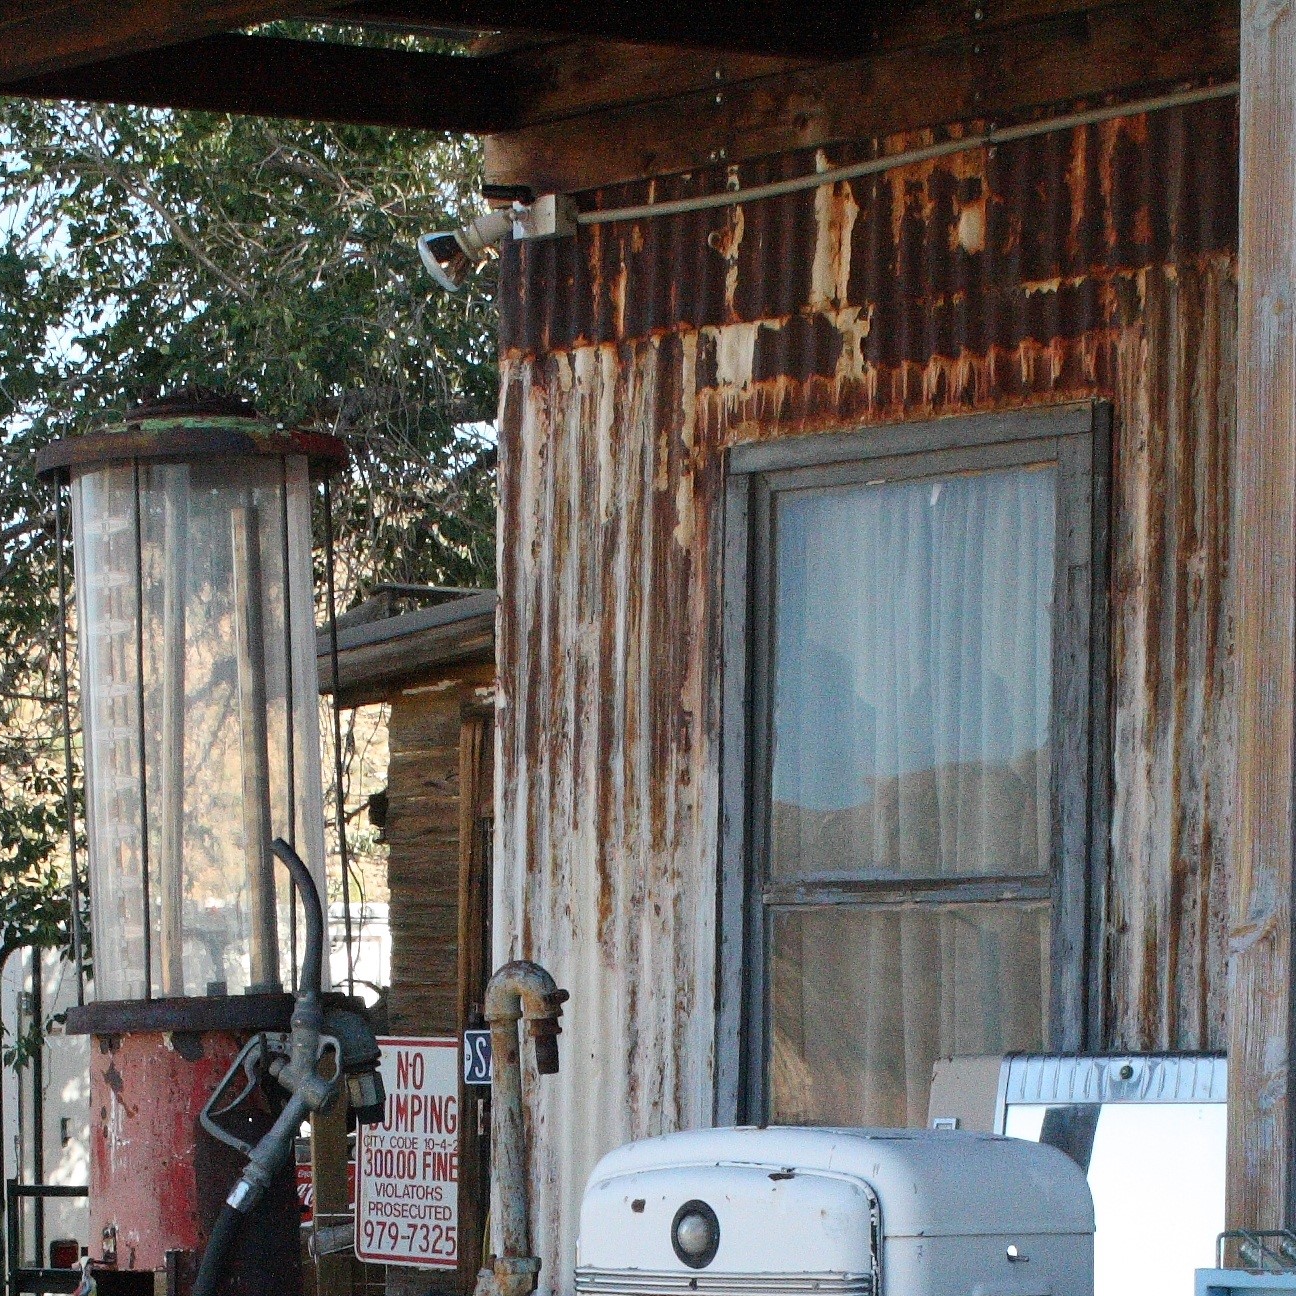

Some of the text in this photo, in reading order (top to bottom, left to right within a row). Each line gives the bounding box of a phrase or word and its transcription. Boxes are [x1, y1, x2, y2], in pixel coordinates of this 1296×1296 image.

[396, 1050, 424, 1090] NO
[370, 1094, 457, 1134] UMPING
[364, 1135, 385, 1147] CITY
[390, 1136, 418, 1149] CODE
[364, 1148, 458, 1182] 300.00 FINE
[375, 1182, 443, 1201] VIOLATORS
[368, 1201, 452, 1220] PROSECUTED
[364, 1219, 457, 1256] 979-7325
